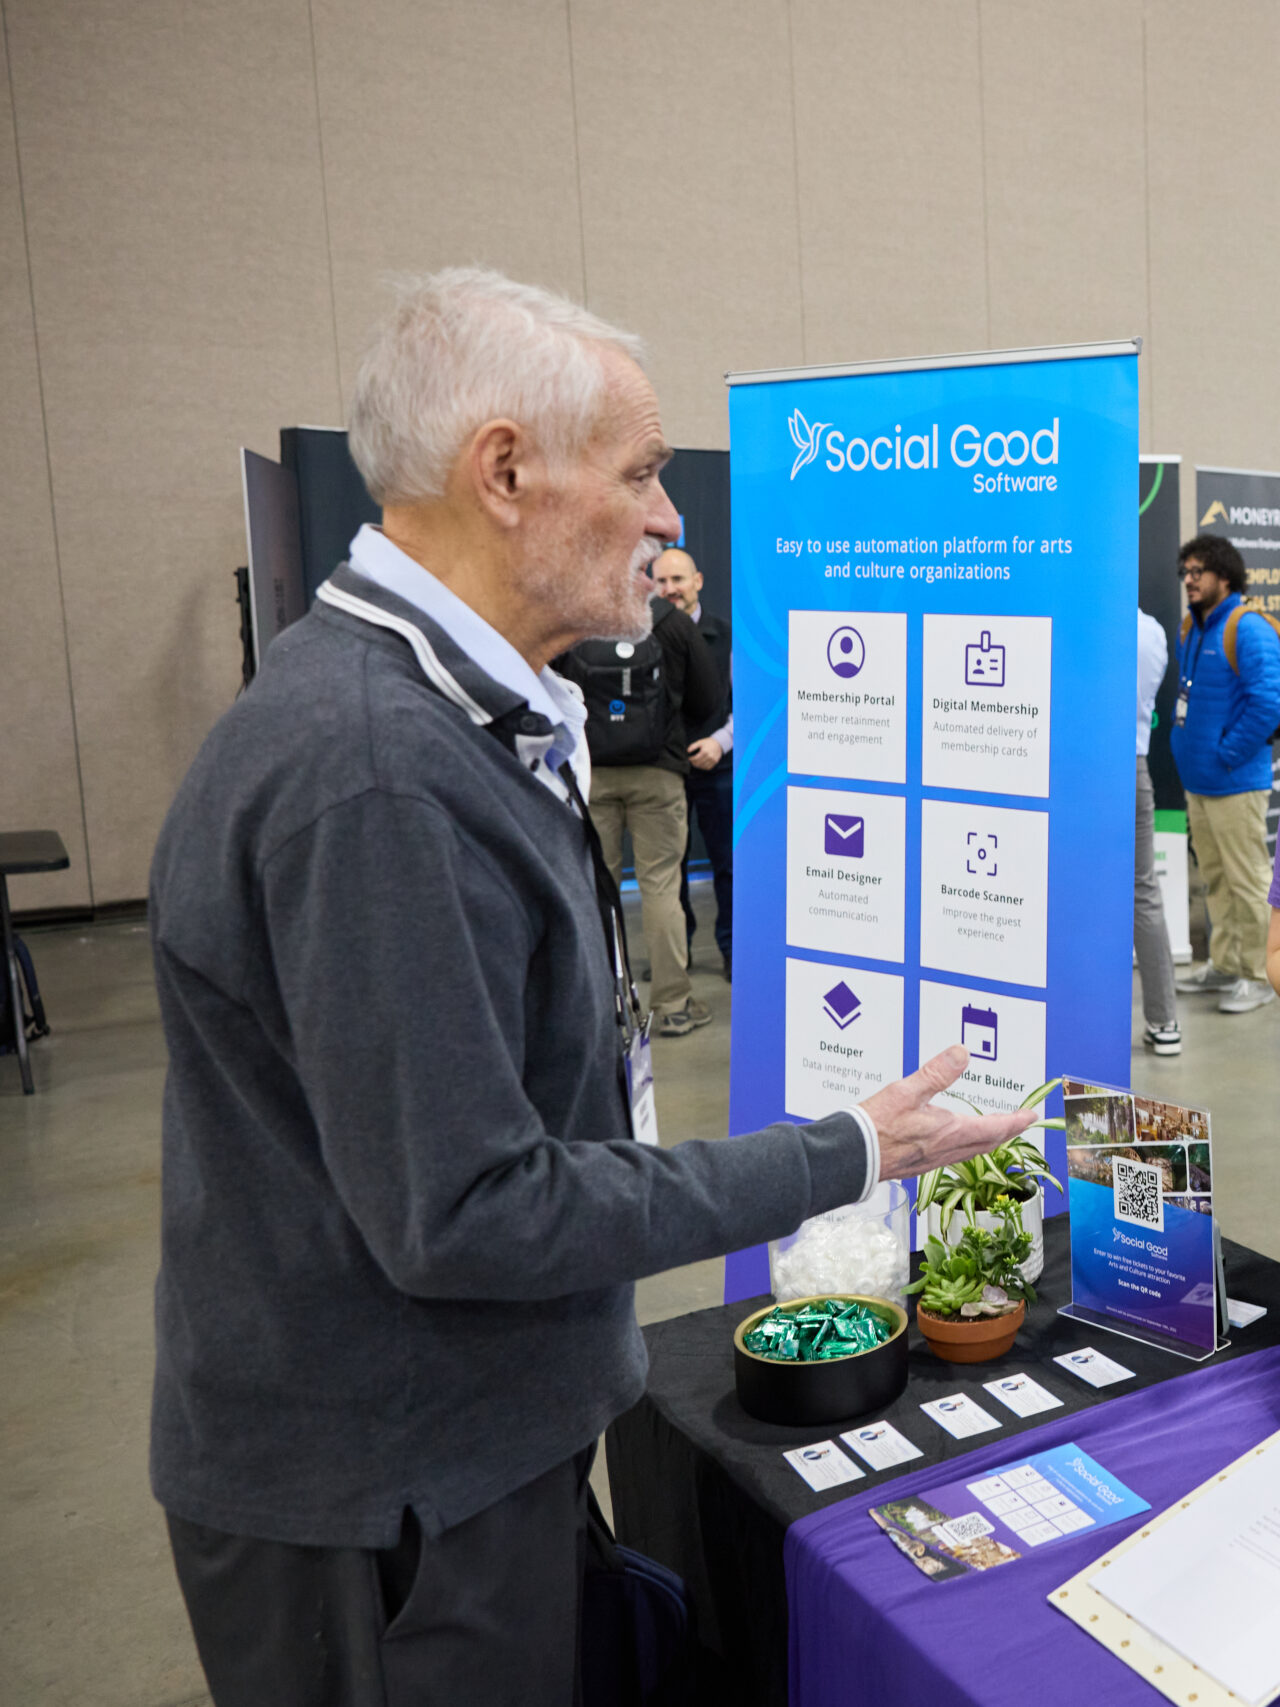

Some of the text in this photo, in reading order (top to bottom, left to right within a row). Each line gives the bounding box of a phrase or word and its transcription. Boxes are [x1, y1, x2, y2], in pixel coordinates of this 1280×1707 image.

[826, 417, 1059, 472] Social Good
[973, 473, 1057, 493] Software
[776, 536, 1072, 558] Easy to use automation platform for arts
[825, 562, 1010, 583] and culture organizations
[798, 690, 895, 707] Membership Portal
[933, 698, 1039, 718] Digital Membership
[801, 712, 890, 728] Member retainment
[808, 730, 883, 745] and engagement
[933, 721, 1038, 740] Automated delivery of
[941, 740, 1028, 757] membership cards
[806, 866, 883, 886] Email Designer
[818, 889, 869, 904] Automated
[941, 884, 1024, 906] Barcode Scanner
[808, 905, 879, 923] communication
[942, 906, 1022, 929] Improve the guest
[957, 926, 1005, 943] experience
[819, 1041, 864, 1058] Deduper
[802, 1058, 882, 1082] Data integrity and
[822, 1079, 860, 1096] clean up
[985, 1074, 1025, 1092] Builder
[968, 1094, 1019, 1112] scheduling
[1121, 1233, 1168, 1256] Social Good
[1093, 1247, 1106, 1257] Enter
[1122, 1256, 1132, 1265] free
[1133, 1260, 1148, 1270] tickets
[1155, 1267, 1166, 1276] your
[1167, 1270, 1186, 1282] favorite
[1109, 1261, 1170, 1285] Arts and Culture attraction
[1118, 1278, 1161, 1298] Scan the QR code
[1074, 1464, 1103, 1487] Social
[1097, 1485, 1124, 1504] Good
